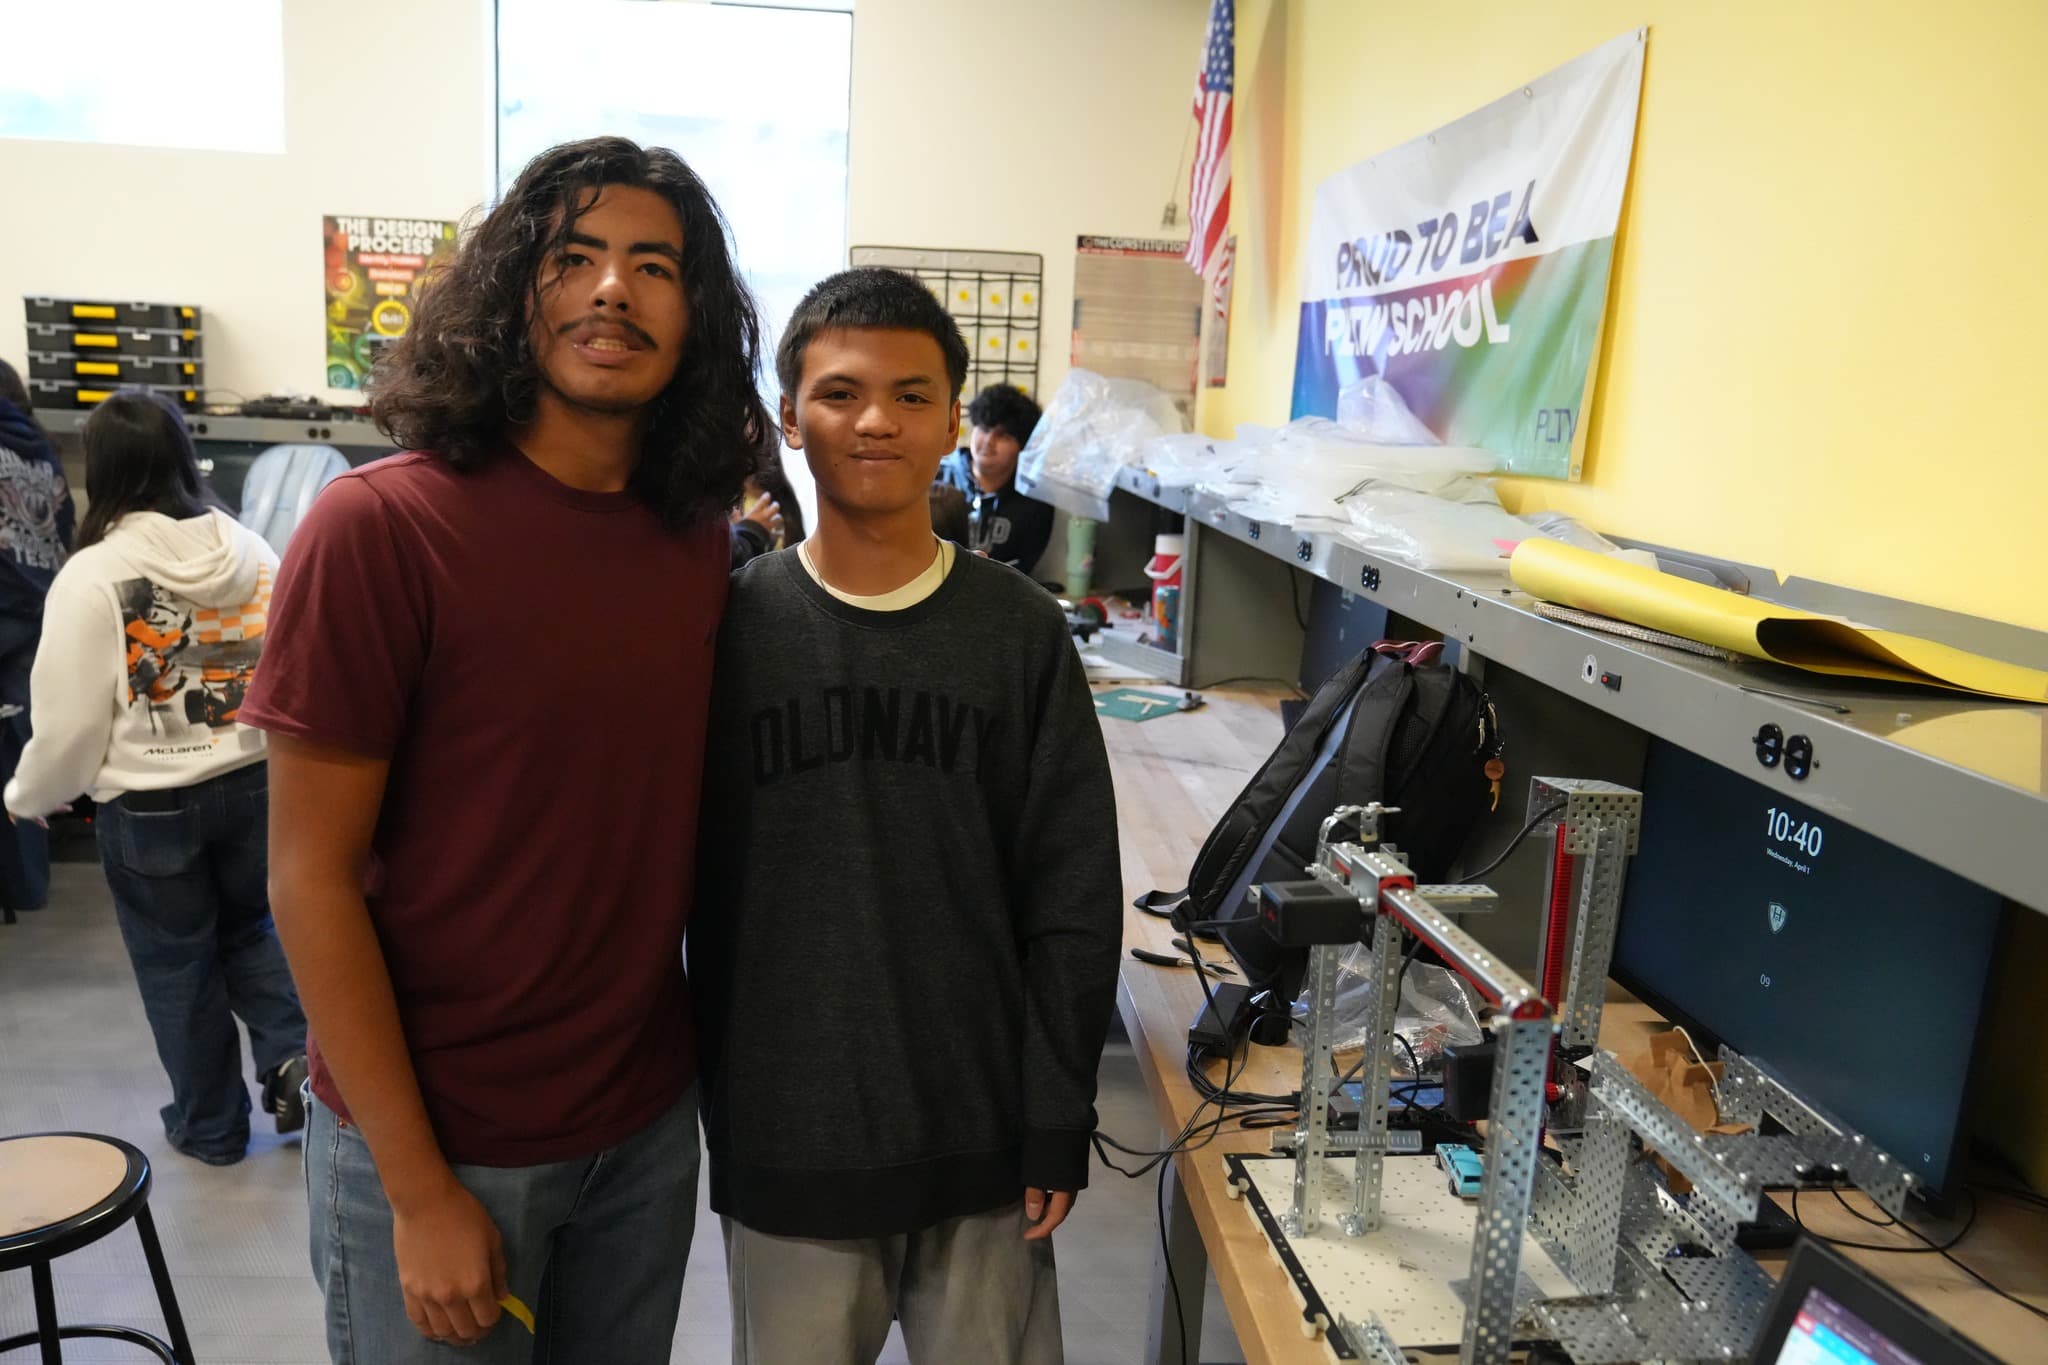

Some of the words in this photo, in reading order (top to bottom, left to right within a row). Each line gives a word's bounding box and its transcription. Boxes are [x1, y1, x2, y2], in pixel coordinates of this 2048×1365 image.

[336, 218, 370, 236] THE
[374, 221, 444, 239] DESIGN
[1416, 211, 1459, 275] TO
[1460, 190, 1512, 264] BE
[1504, 179, 1539, 249] A
[348, 236, 434, 255] PROCESS
[1388, 279, 1510, 357] SCHOOL
[751, 686, 854, 785] OLD
[863, 687, 1009, 784] NAVY
[143, 743, 213, 756] McLaren
[1767, 807, 1823, 857] 10:40
[1766, 847, 1793, 867] Wednesday,
[1794, 861, 1807, 873] April
[1760, 974, 1771, 987] 09
